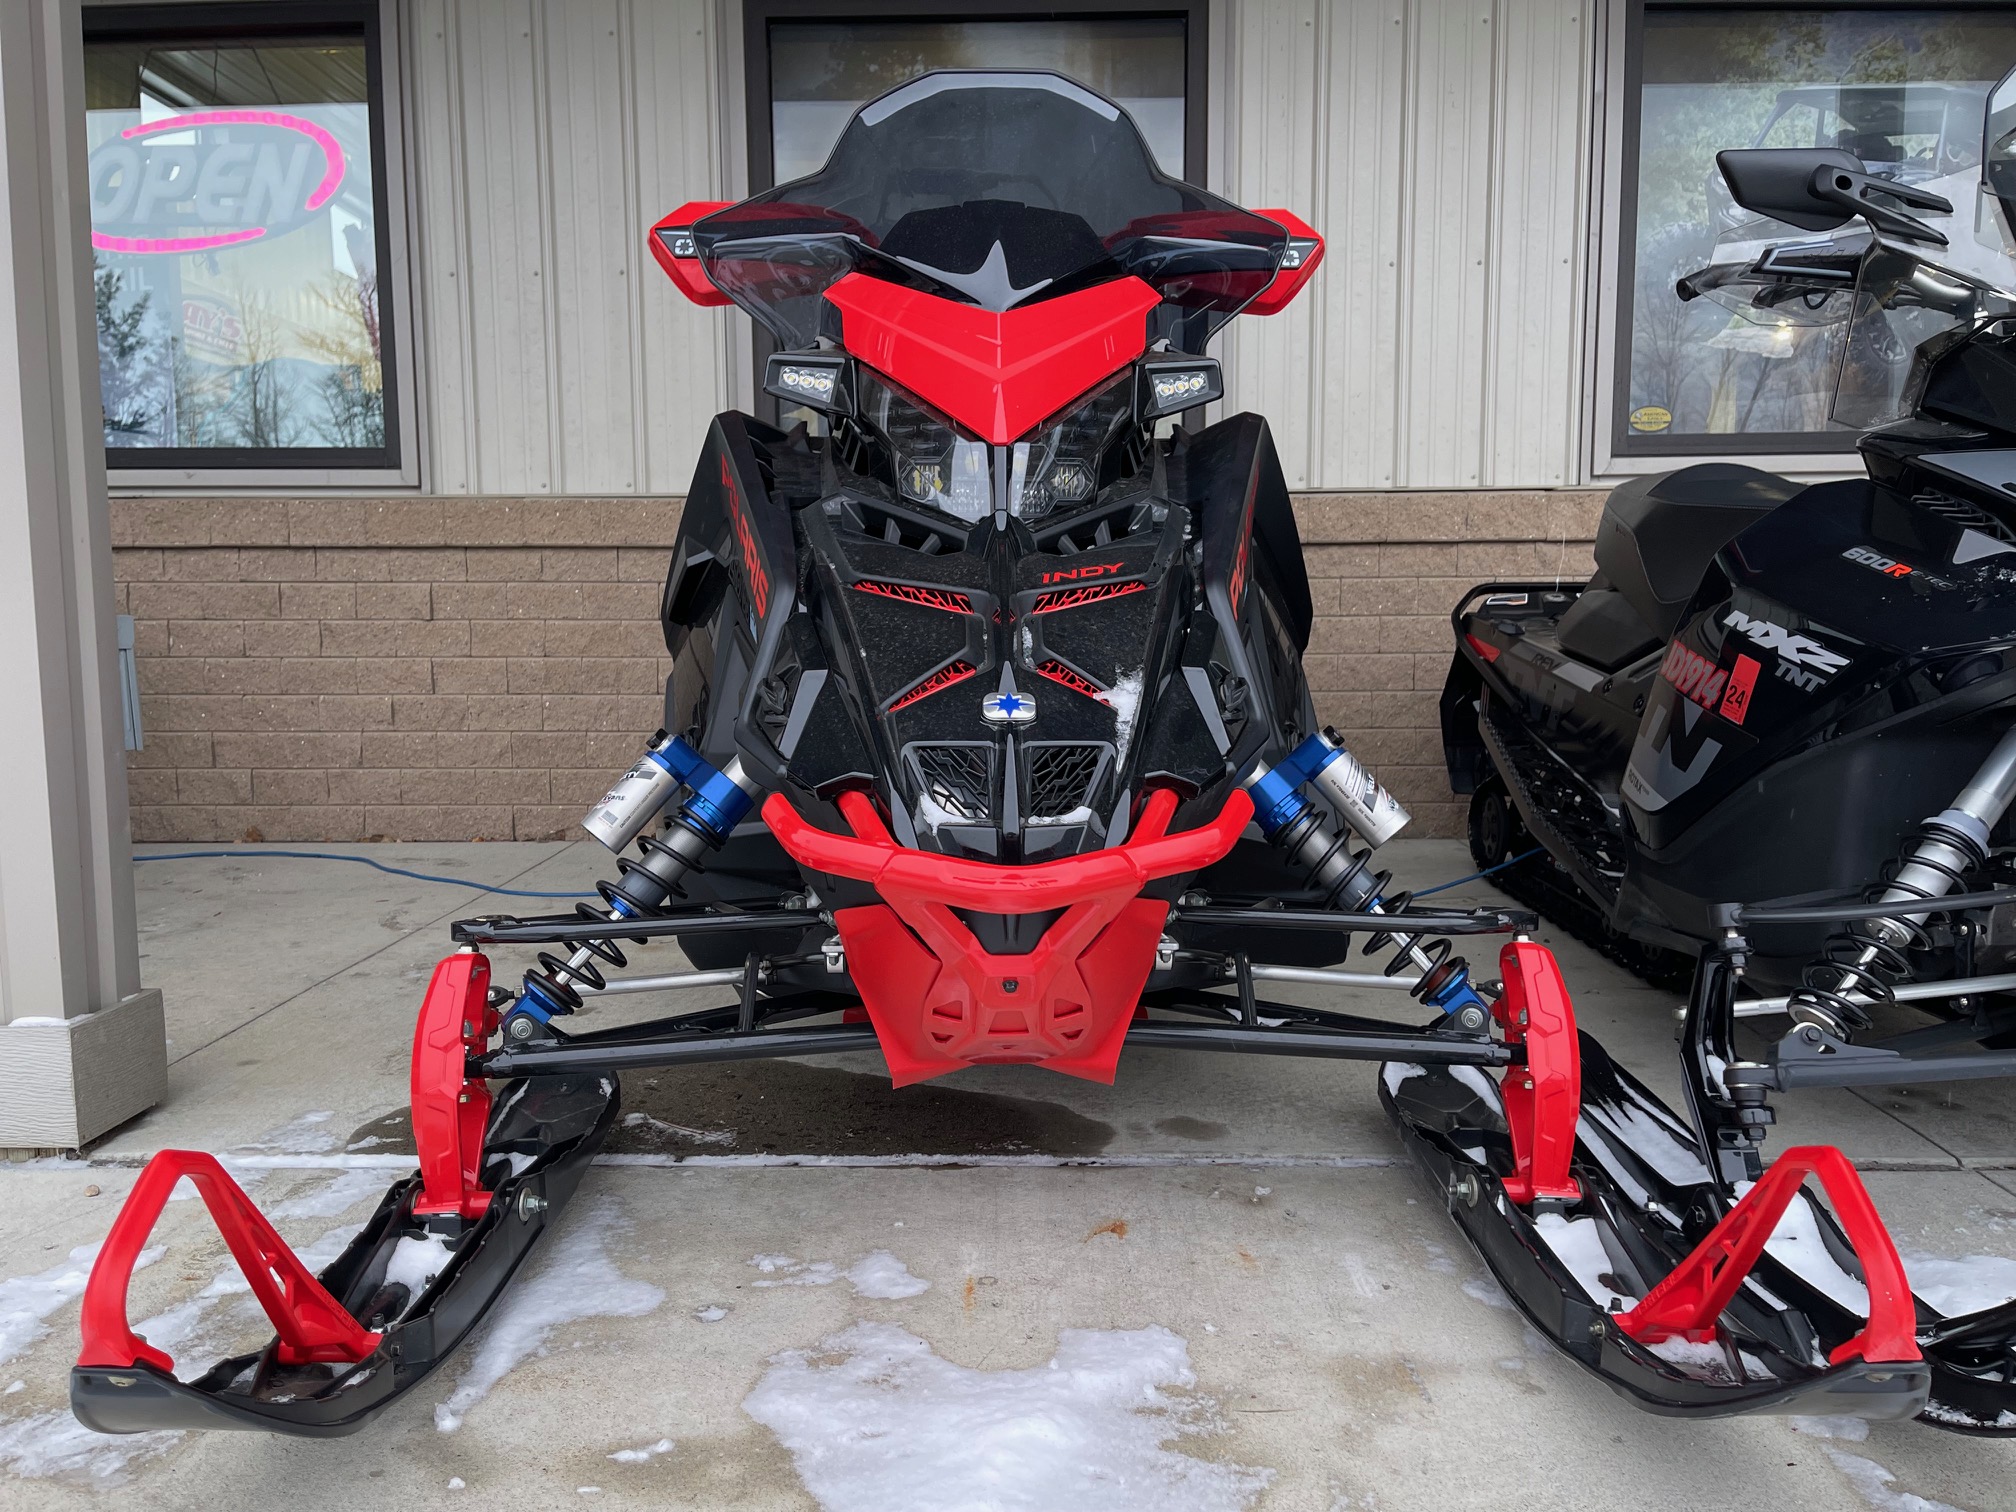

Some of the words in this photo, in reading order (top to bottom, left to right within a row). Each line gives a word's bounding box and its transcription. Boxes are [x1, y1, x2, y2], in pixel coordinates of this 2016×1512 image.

[88, 141, 313, 226] OPEN
[721, 452, 769, 619] POLARIS
[1042, 562, 1125, 584] INDY
[1841, 547, 1913, 578] 600R
[1722, 609, 1851, 674] MXZ
[1774, 657, 1827, 692] TNT
[1725, 684, 1746, 709] 24
